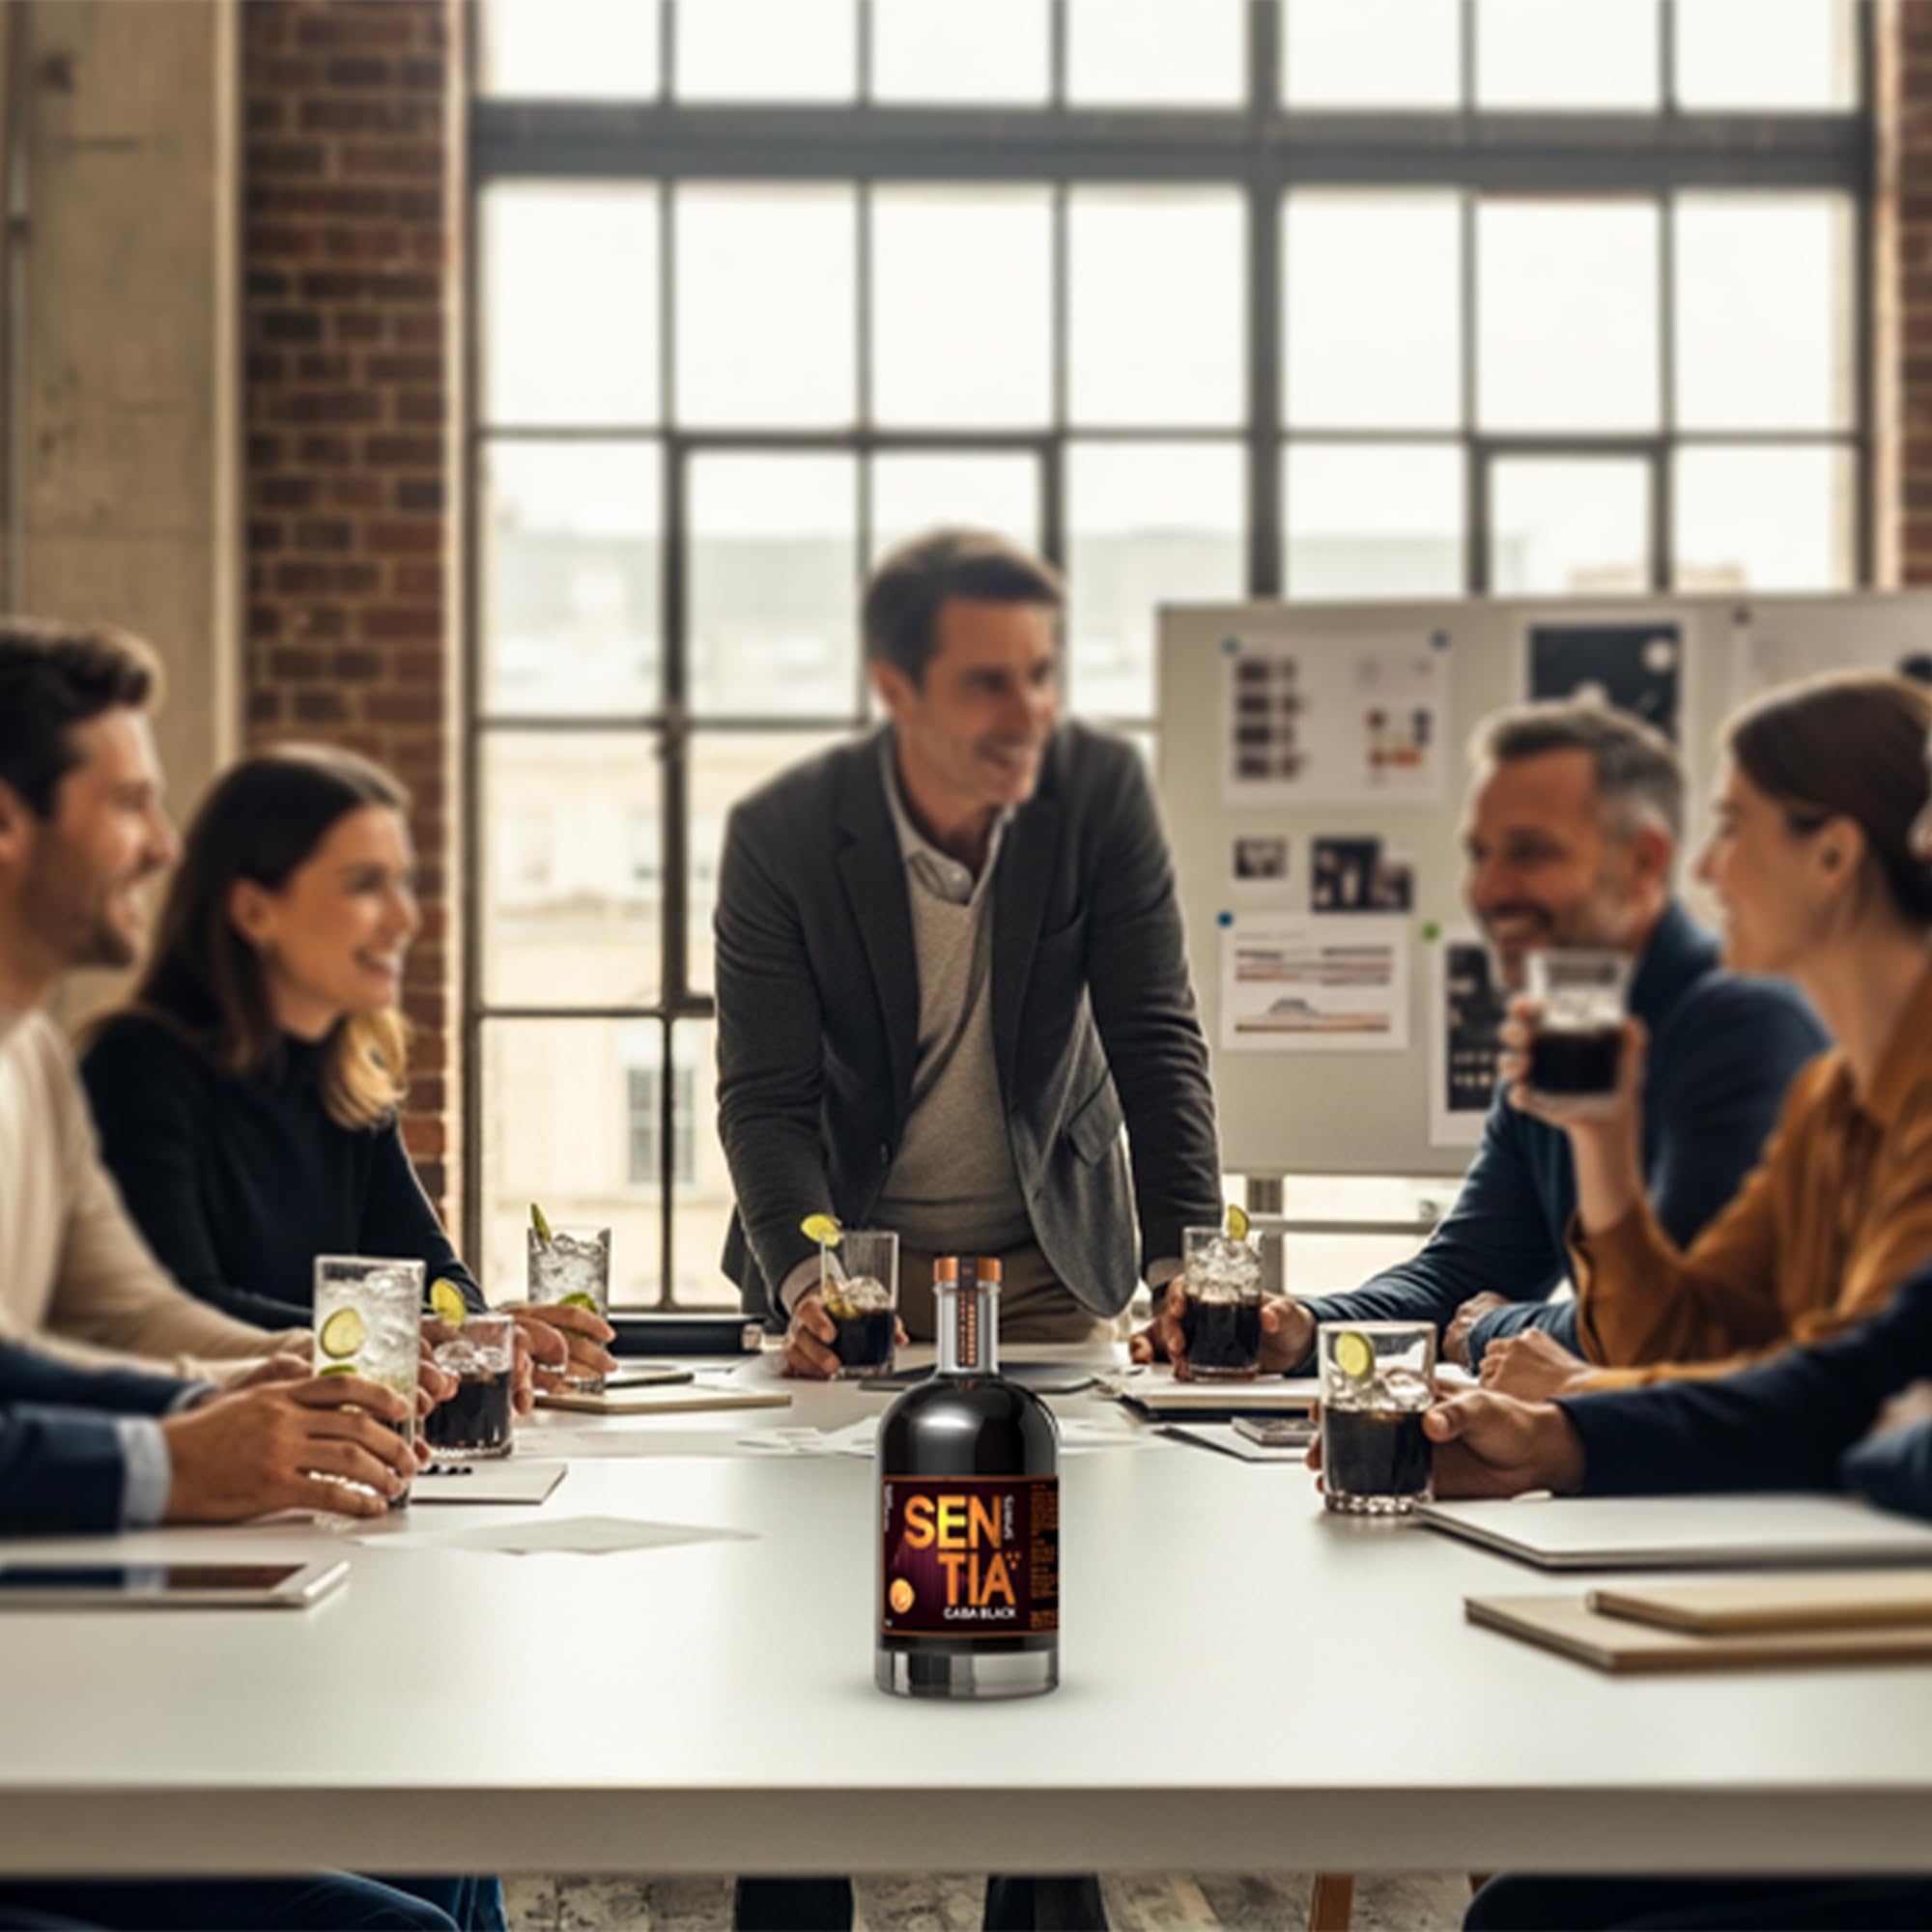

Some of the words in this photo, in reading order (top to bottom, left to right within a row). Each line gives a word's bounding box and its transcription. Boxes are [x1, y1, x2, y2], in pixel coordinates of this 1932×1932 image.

[903, 1494, 1003, 1549] SEN
[937, 1552, 1016, 1605] TIA
[980, 1606, 1018, 1620] BLACK
